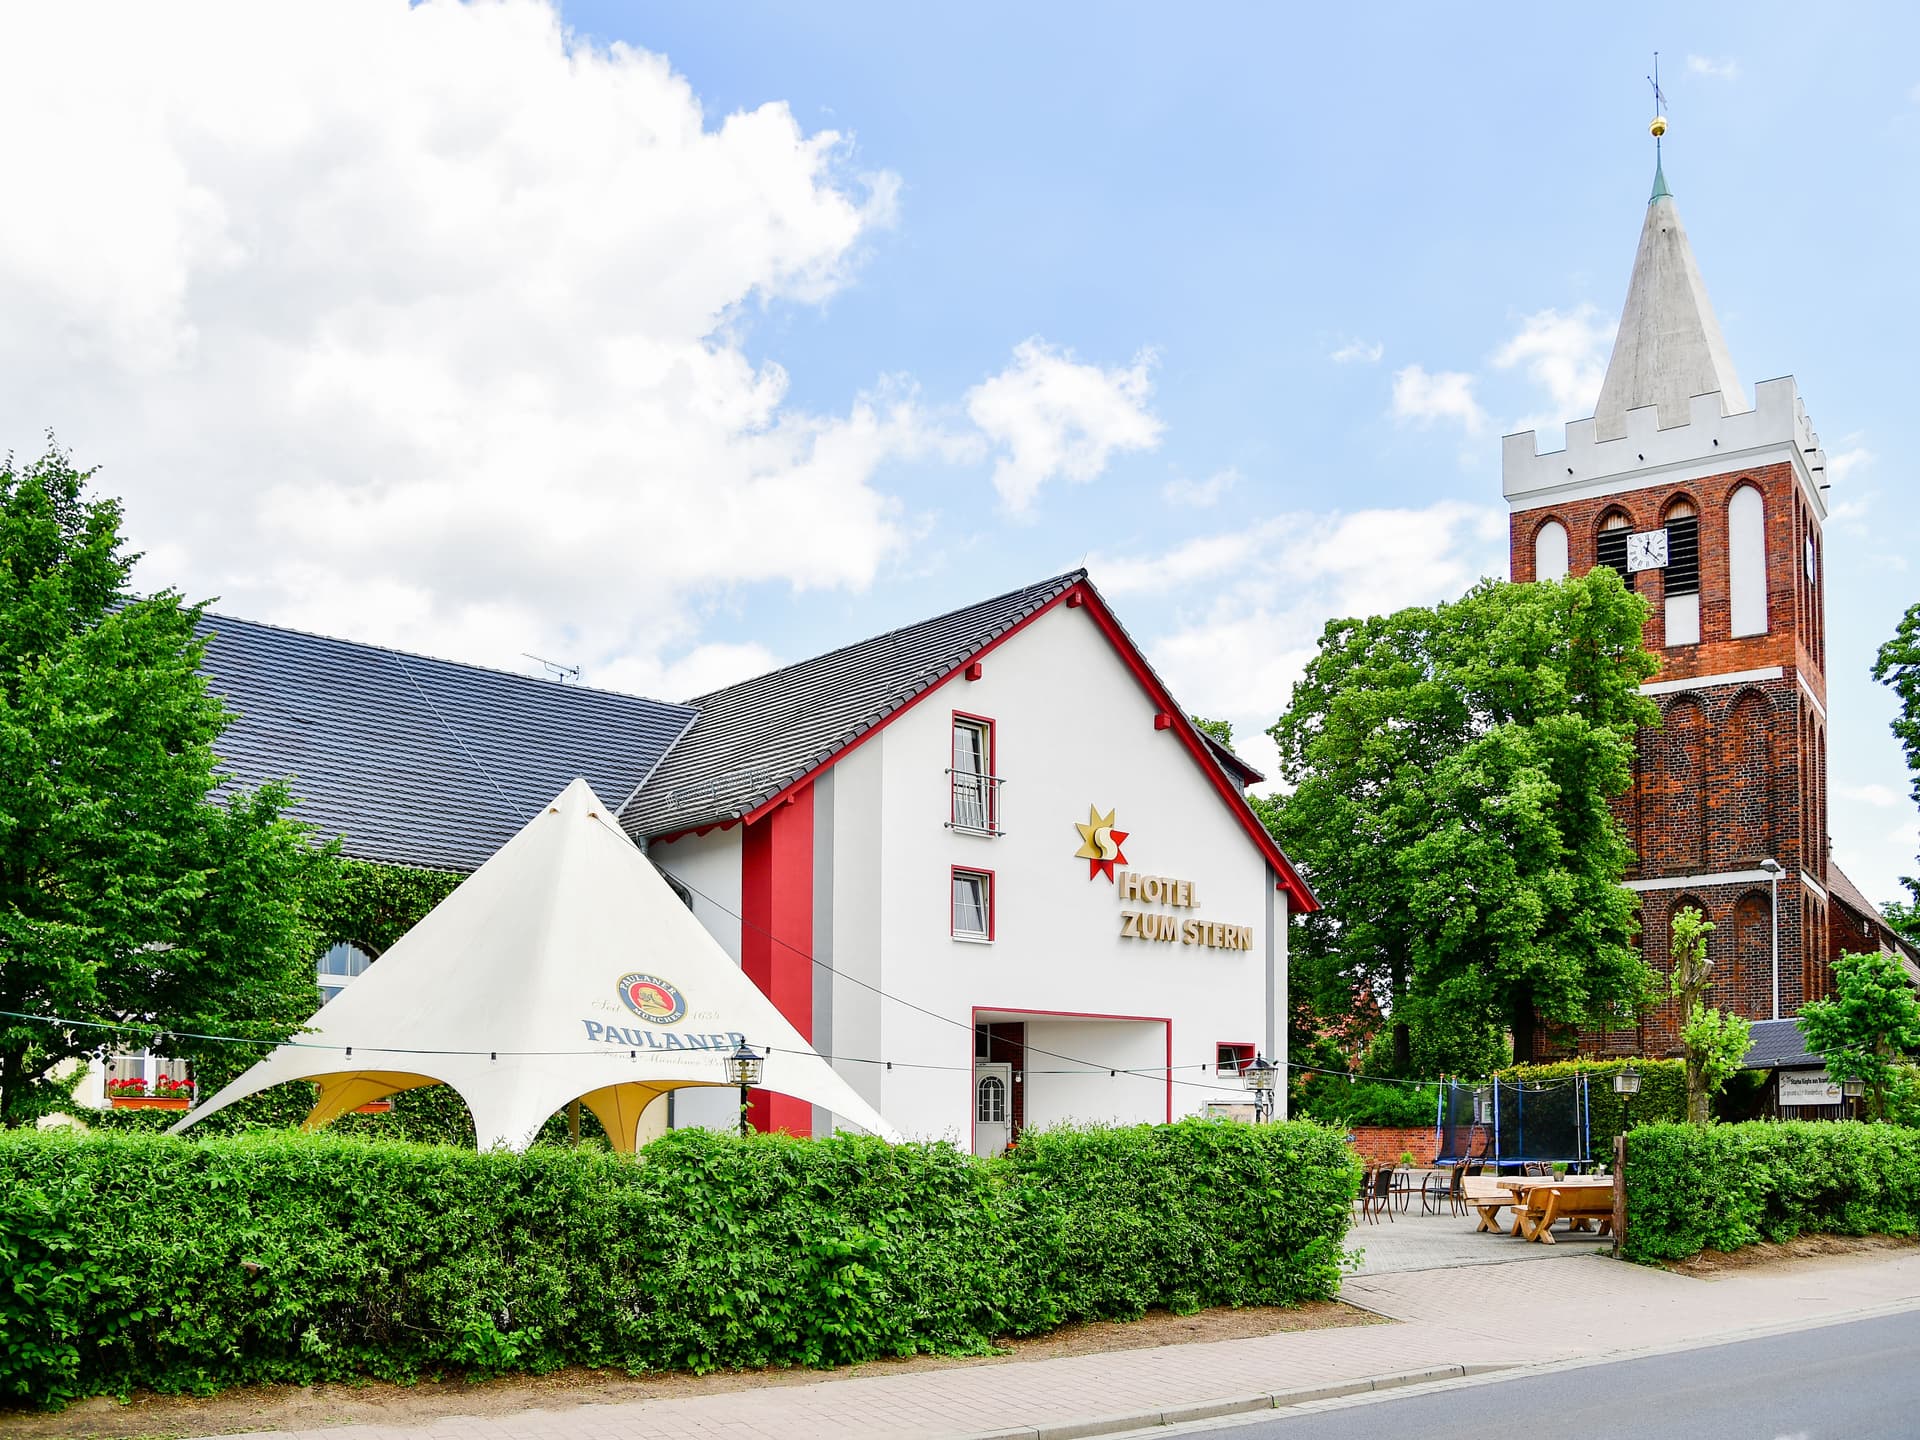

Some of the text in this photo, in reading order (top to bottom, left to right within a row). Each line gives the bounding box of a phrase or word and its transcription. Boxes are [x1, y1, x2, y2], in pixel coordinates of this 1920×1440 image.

[1119, 871, 1201, 908] HOTEL
[1120, 910, 1253, 951] ZUM STERN
[620, 974, 677, 996] PAULANER
